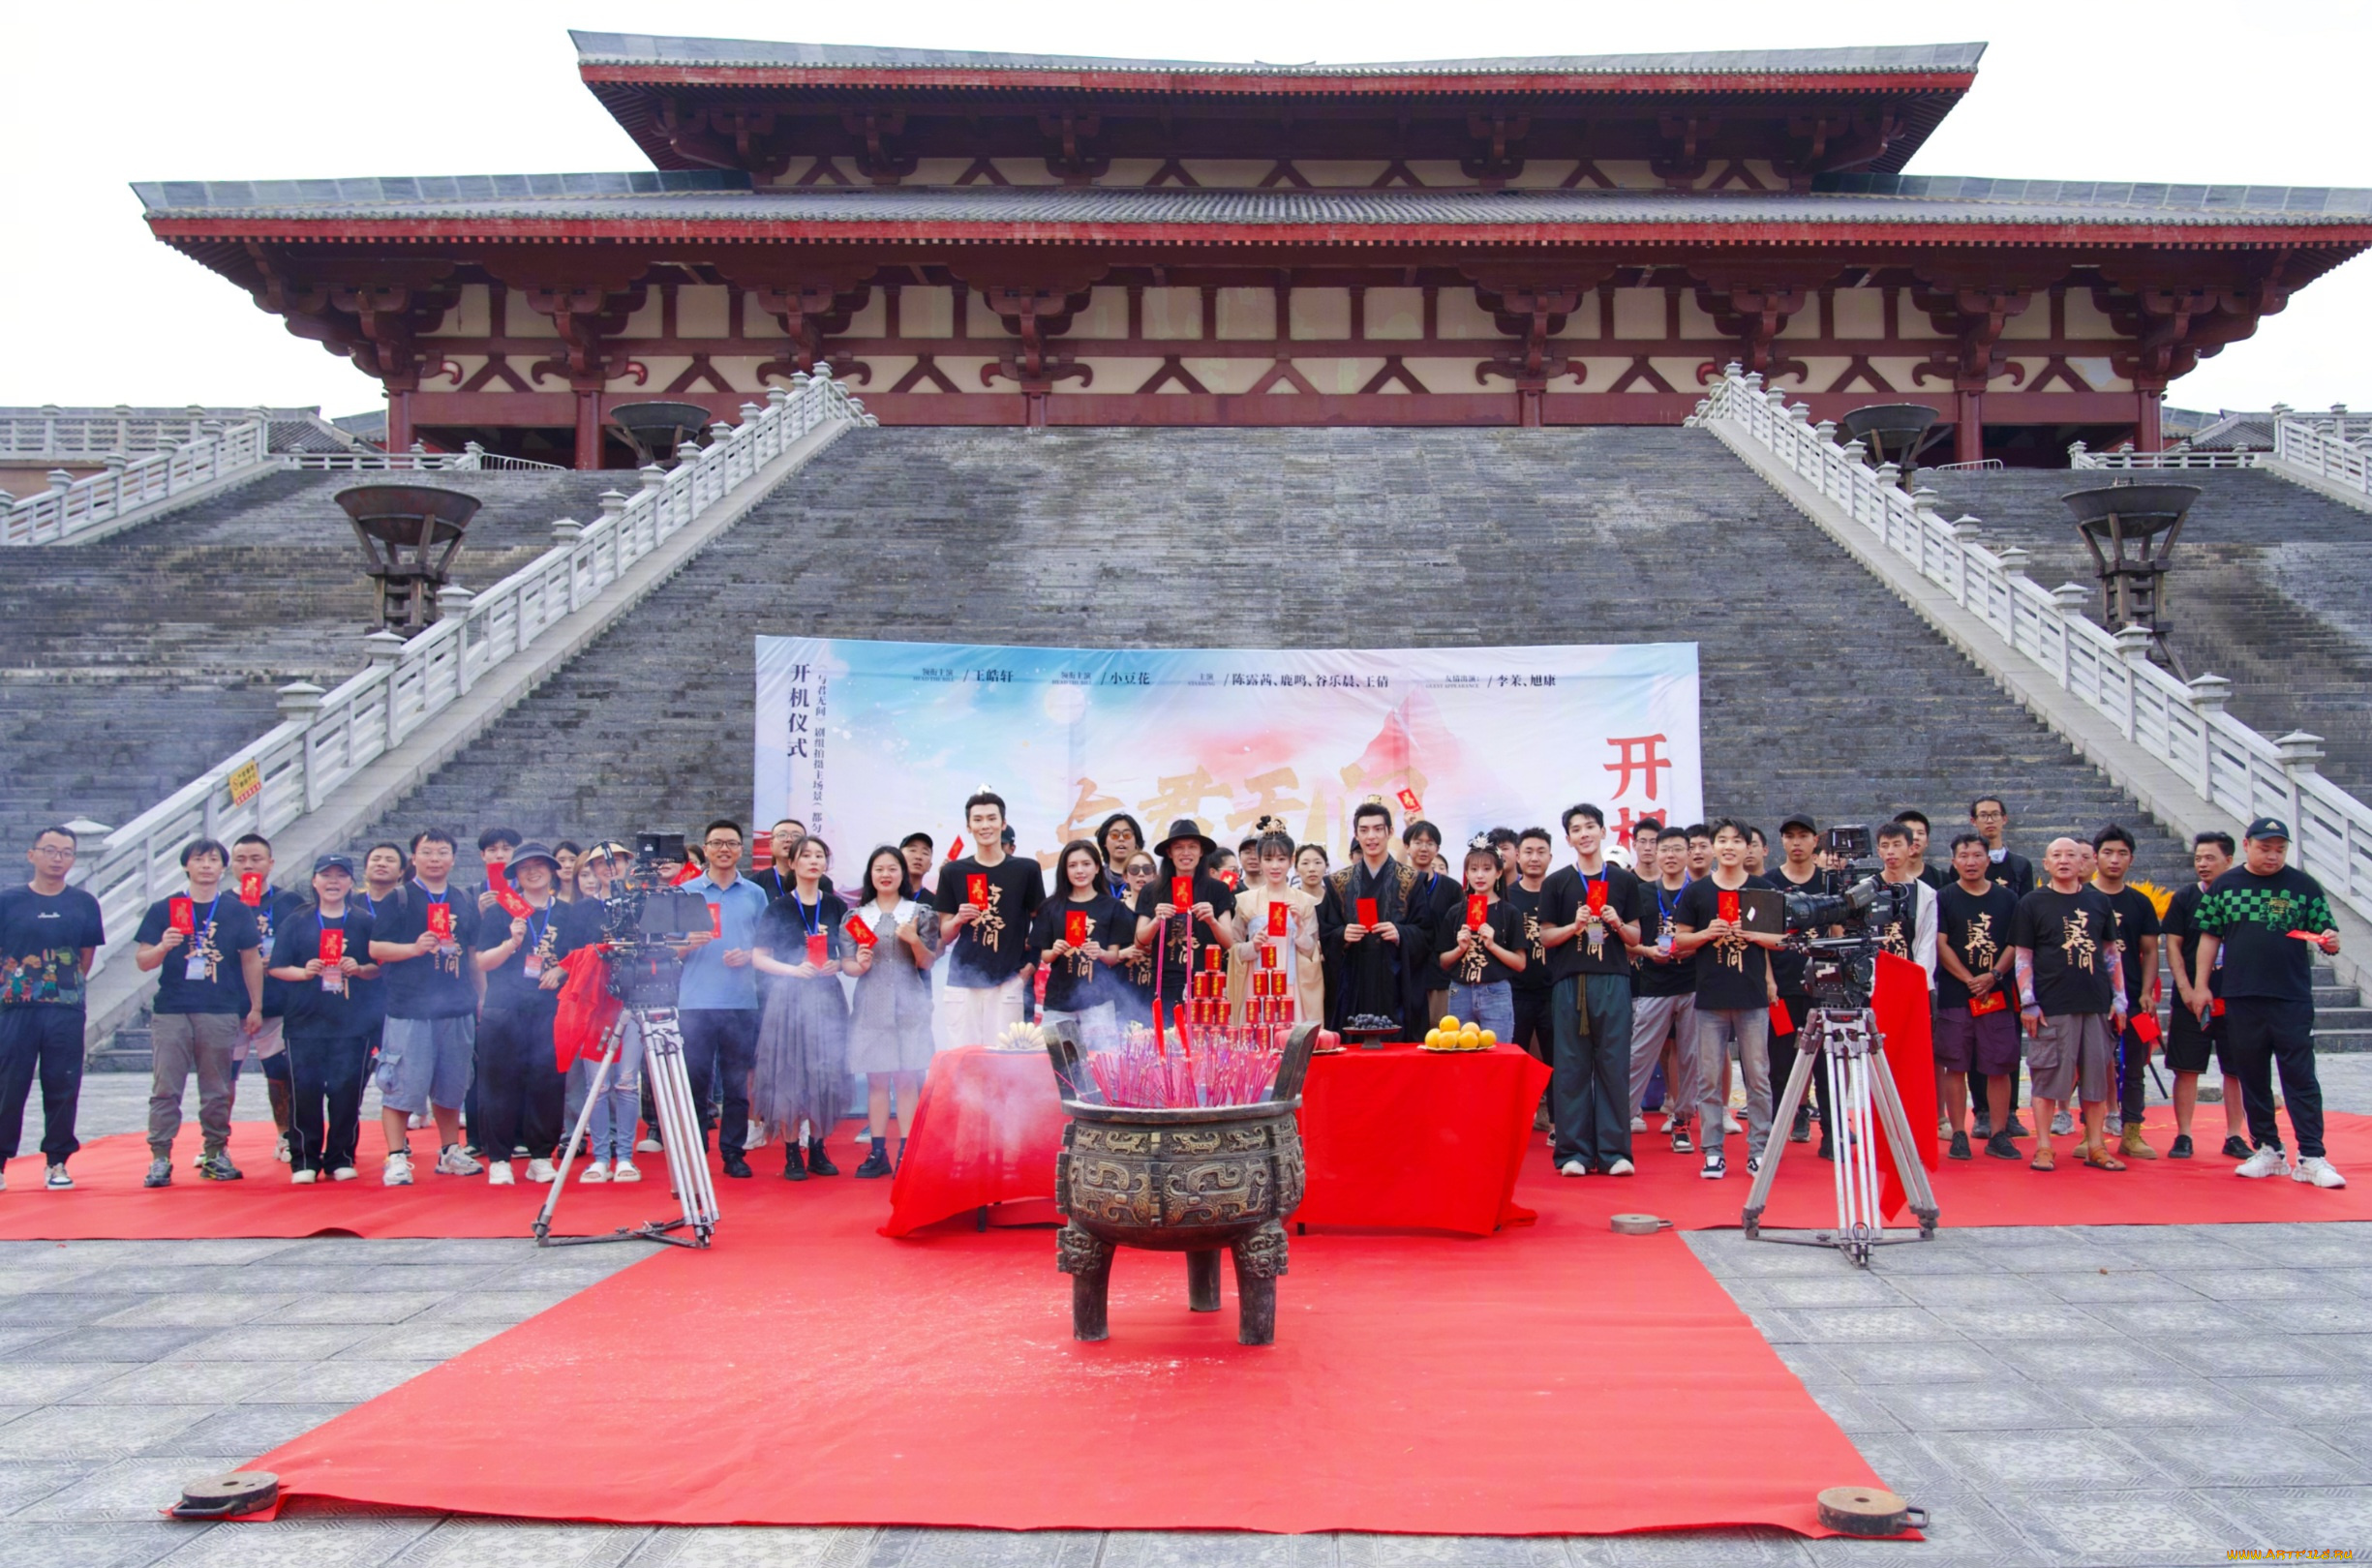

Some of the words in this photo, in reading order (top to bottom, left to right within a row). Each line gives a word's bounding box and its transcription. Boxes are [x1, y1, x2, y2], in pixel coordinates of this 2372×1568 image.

[1110, 672, 1150, 685] 小豆花
[788, 663, 810, 758] 开机仪式
